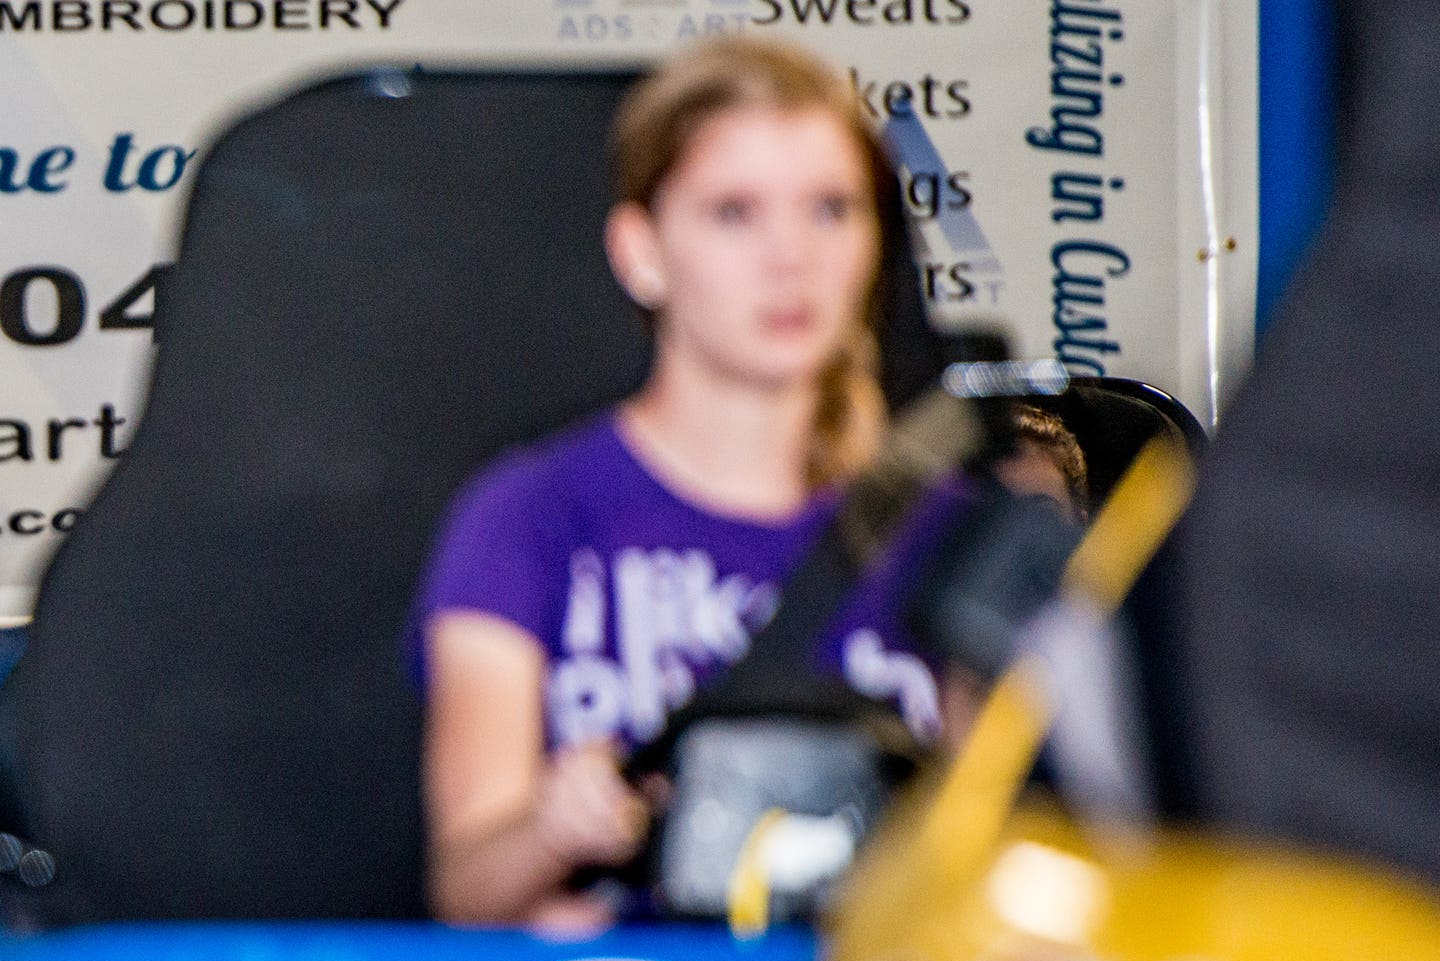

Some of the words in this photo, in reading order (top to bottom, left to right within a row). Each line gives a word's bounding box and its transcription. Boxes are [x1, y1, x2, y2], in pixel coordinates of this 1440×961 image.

[1025, 0, 1125, 155] lizing
[103, 133, 197, 192] to
[1051, 171, 1125, 223] in
